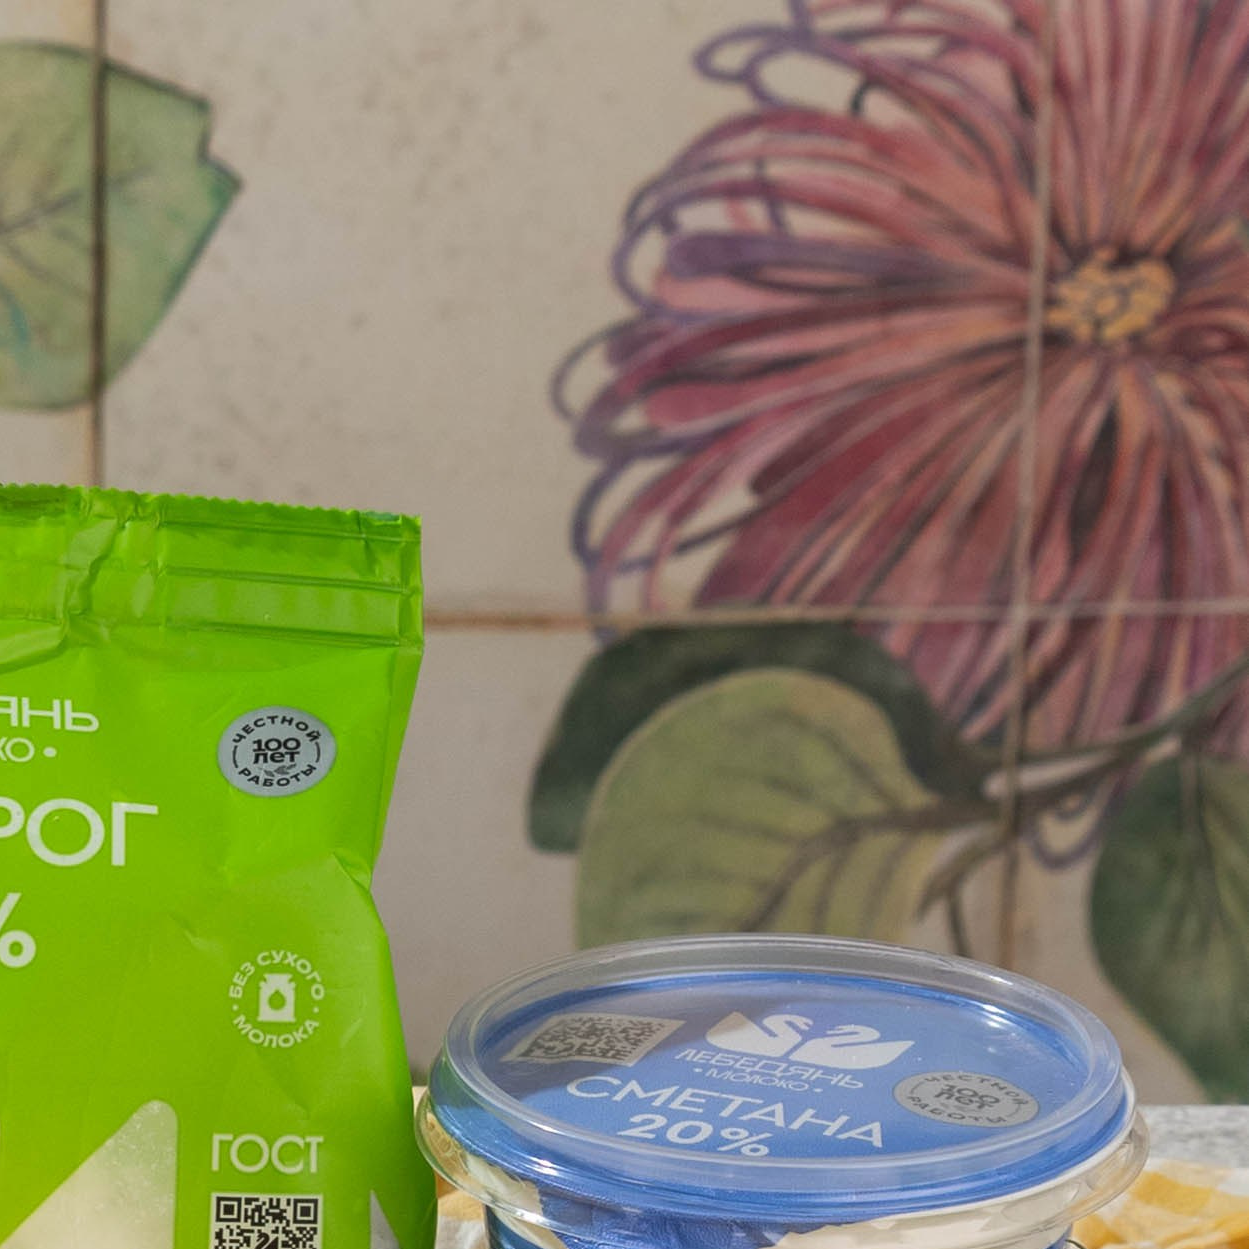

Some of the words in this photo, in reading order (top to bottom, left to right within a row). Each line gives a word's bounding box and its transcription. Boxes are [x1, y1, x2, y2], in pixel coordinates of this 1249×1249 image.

[233, 715, 321, 744] ЧЕСТНОЙ
[252, 737, 301, 752] 100
[238, 763, 316, 787] РАБОТЫ
[253, 752, 300, 764] лет
[229, 961, 255, 999] БЕЗ
[256, 950, 325, 1000] СУХОГО
[233, 1014, 319, 1048] МОЛОКА
[675, 1049, 864, 1089] ЛЕБЕДЯНЬ
[705, 1068, 810, 1093] МОЛОКО
[566, 1075, 884, 1148] СМЕТАНА
[617, 1113, 773, 1157] 20%
[210, 1133, 324, 1174] ГОСТ
